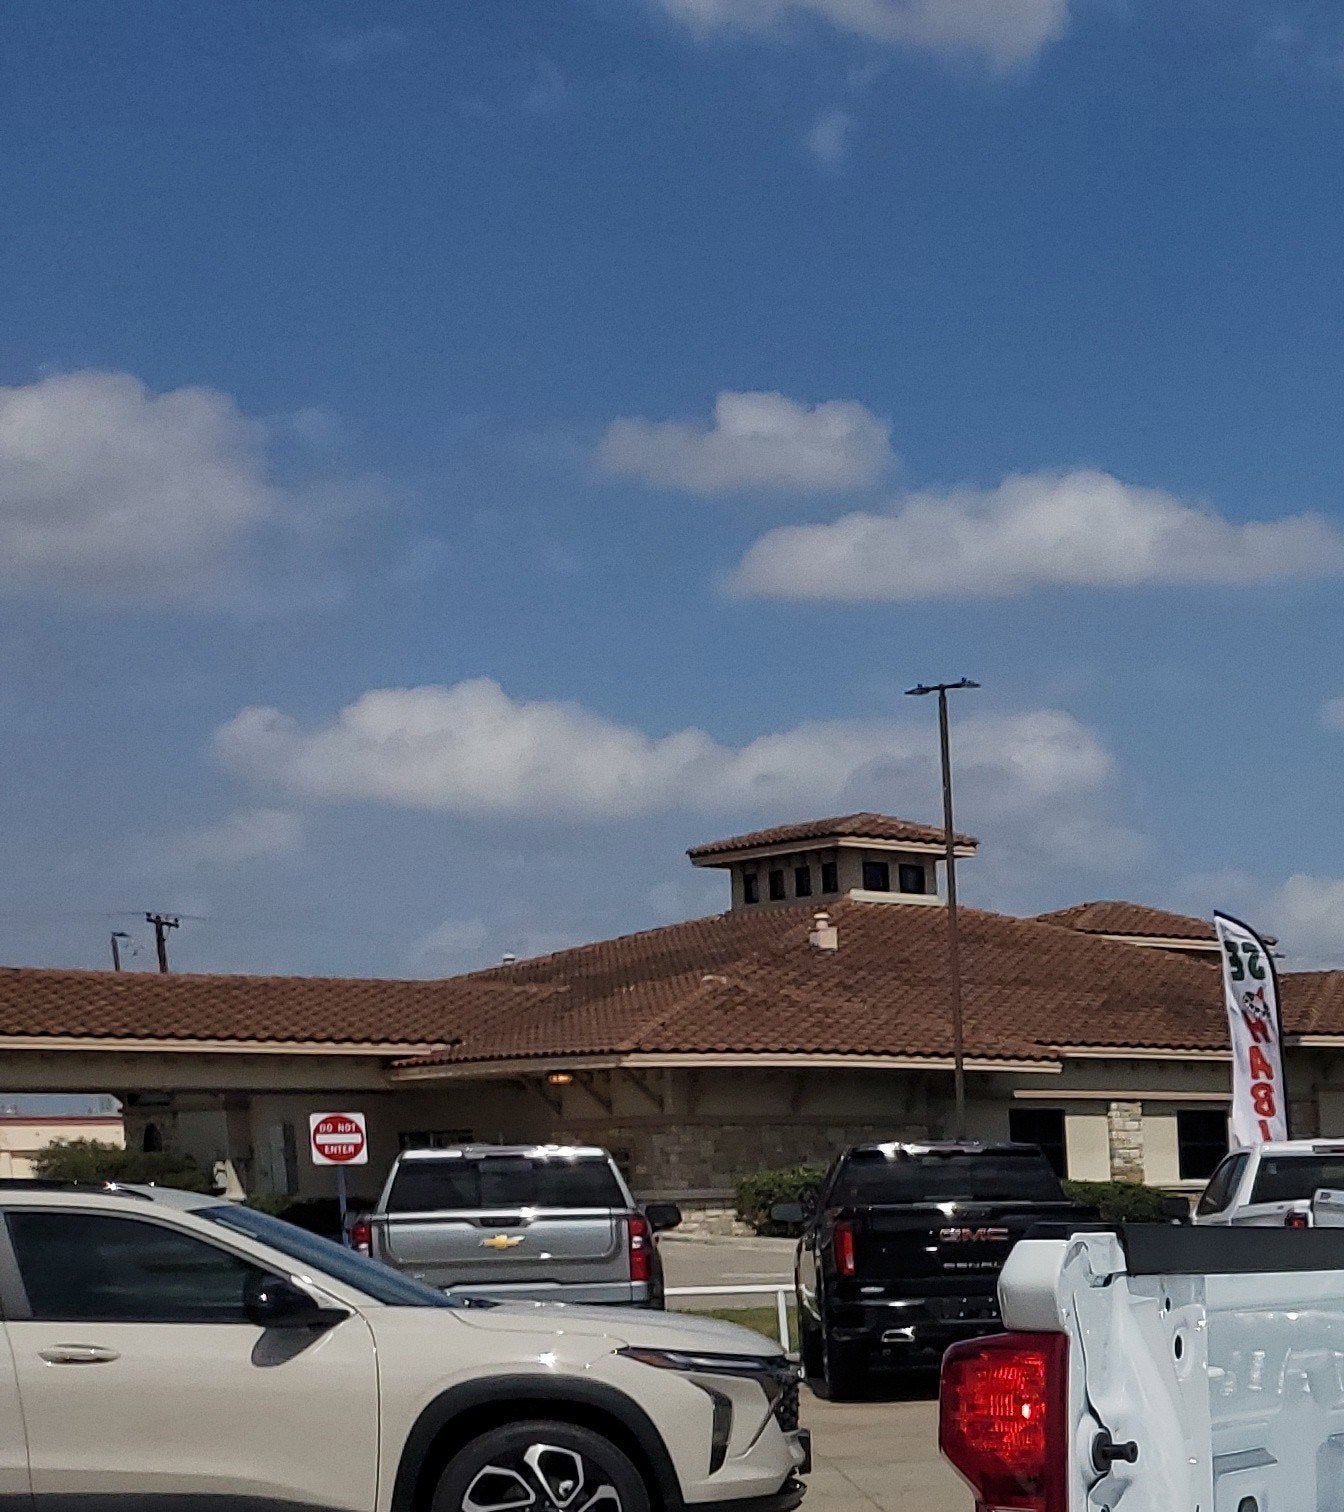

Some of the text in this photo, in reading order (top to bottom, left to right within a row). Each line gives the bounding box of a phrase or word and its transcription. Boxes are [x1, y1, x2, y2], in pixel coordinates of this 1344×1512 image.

[319, 1122, 356, 1133] DO NOT
[324, 1145, 355, 1155] ENTER
[940, 1228, 1009, 1241] GMC
